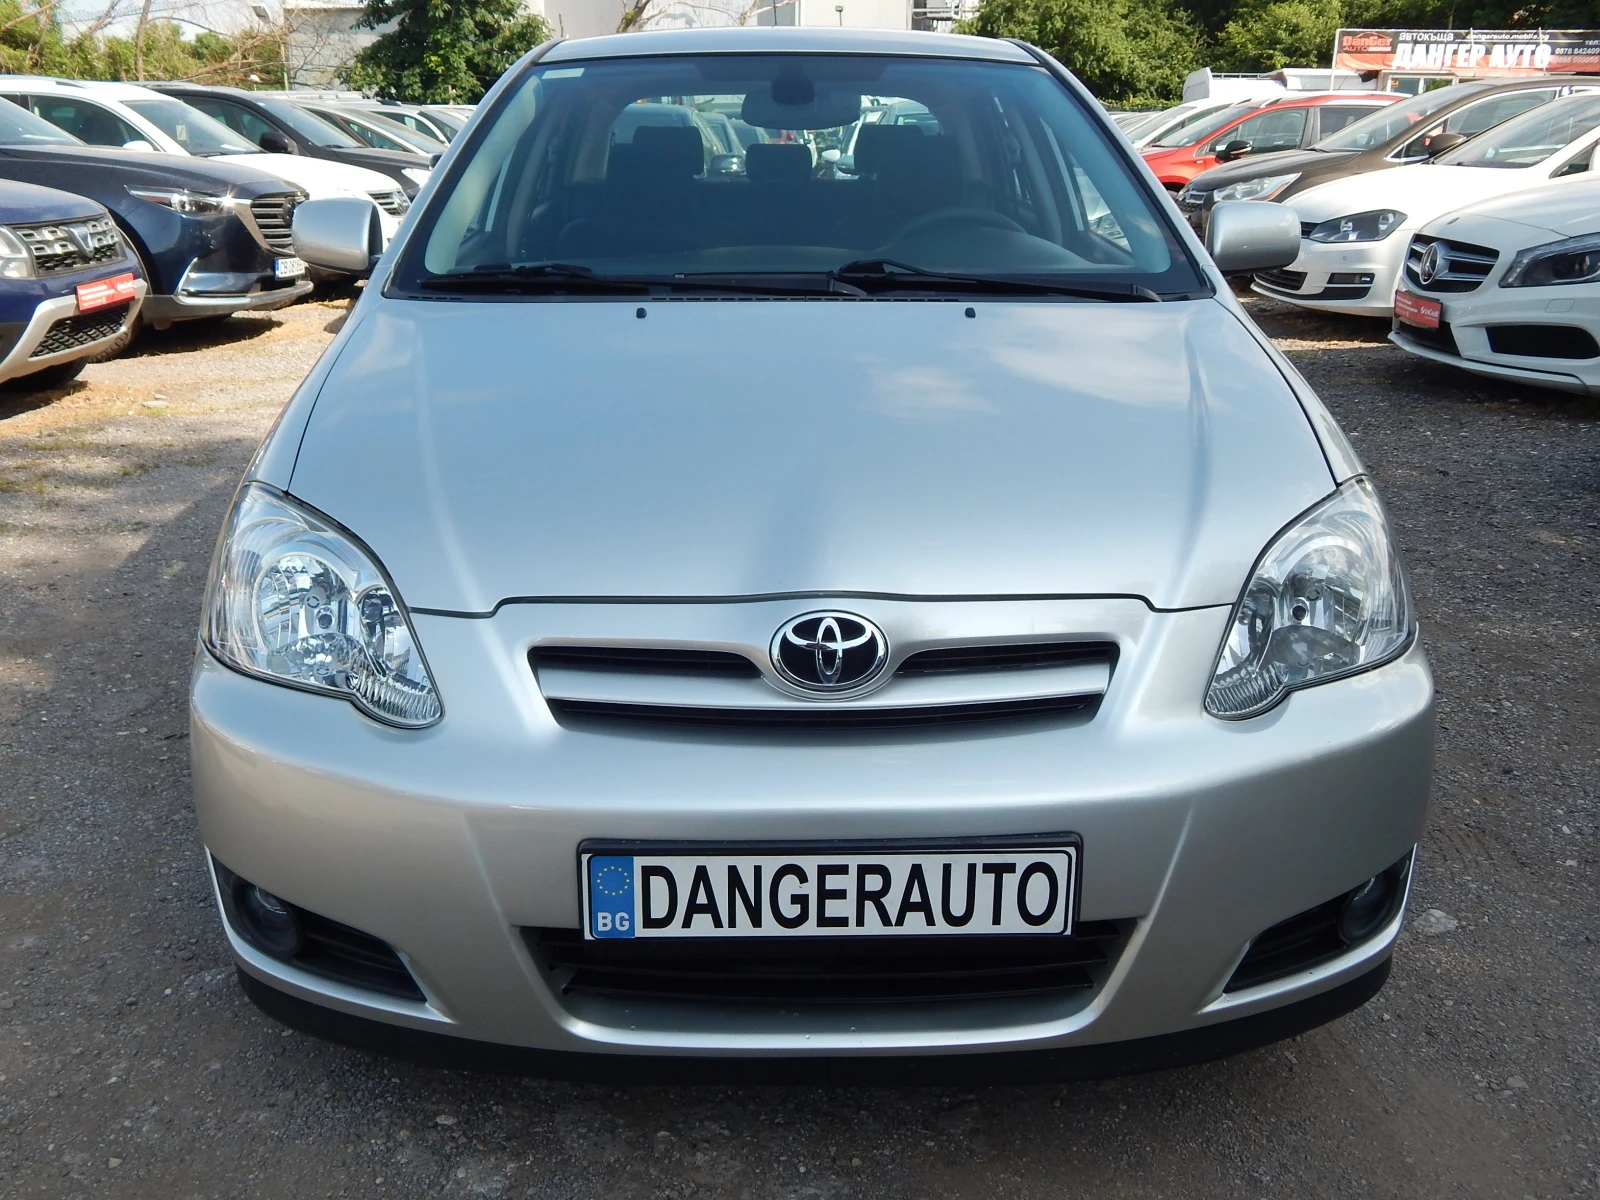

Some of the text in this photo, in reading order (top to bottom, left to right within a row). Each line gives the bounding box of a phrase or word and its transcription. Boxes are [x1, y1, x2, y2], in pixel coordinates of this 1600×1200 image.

[1399, 32, 1454, 42] автокъща
[1391, 43, 1552, 70] ДАНГЕР АУТО
[641, 861, 1059, 930] DANGERAUTO
[597, 912, 630, 932] BG
